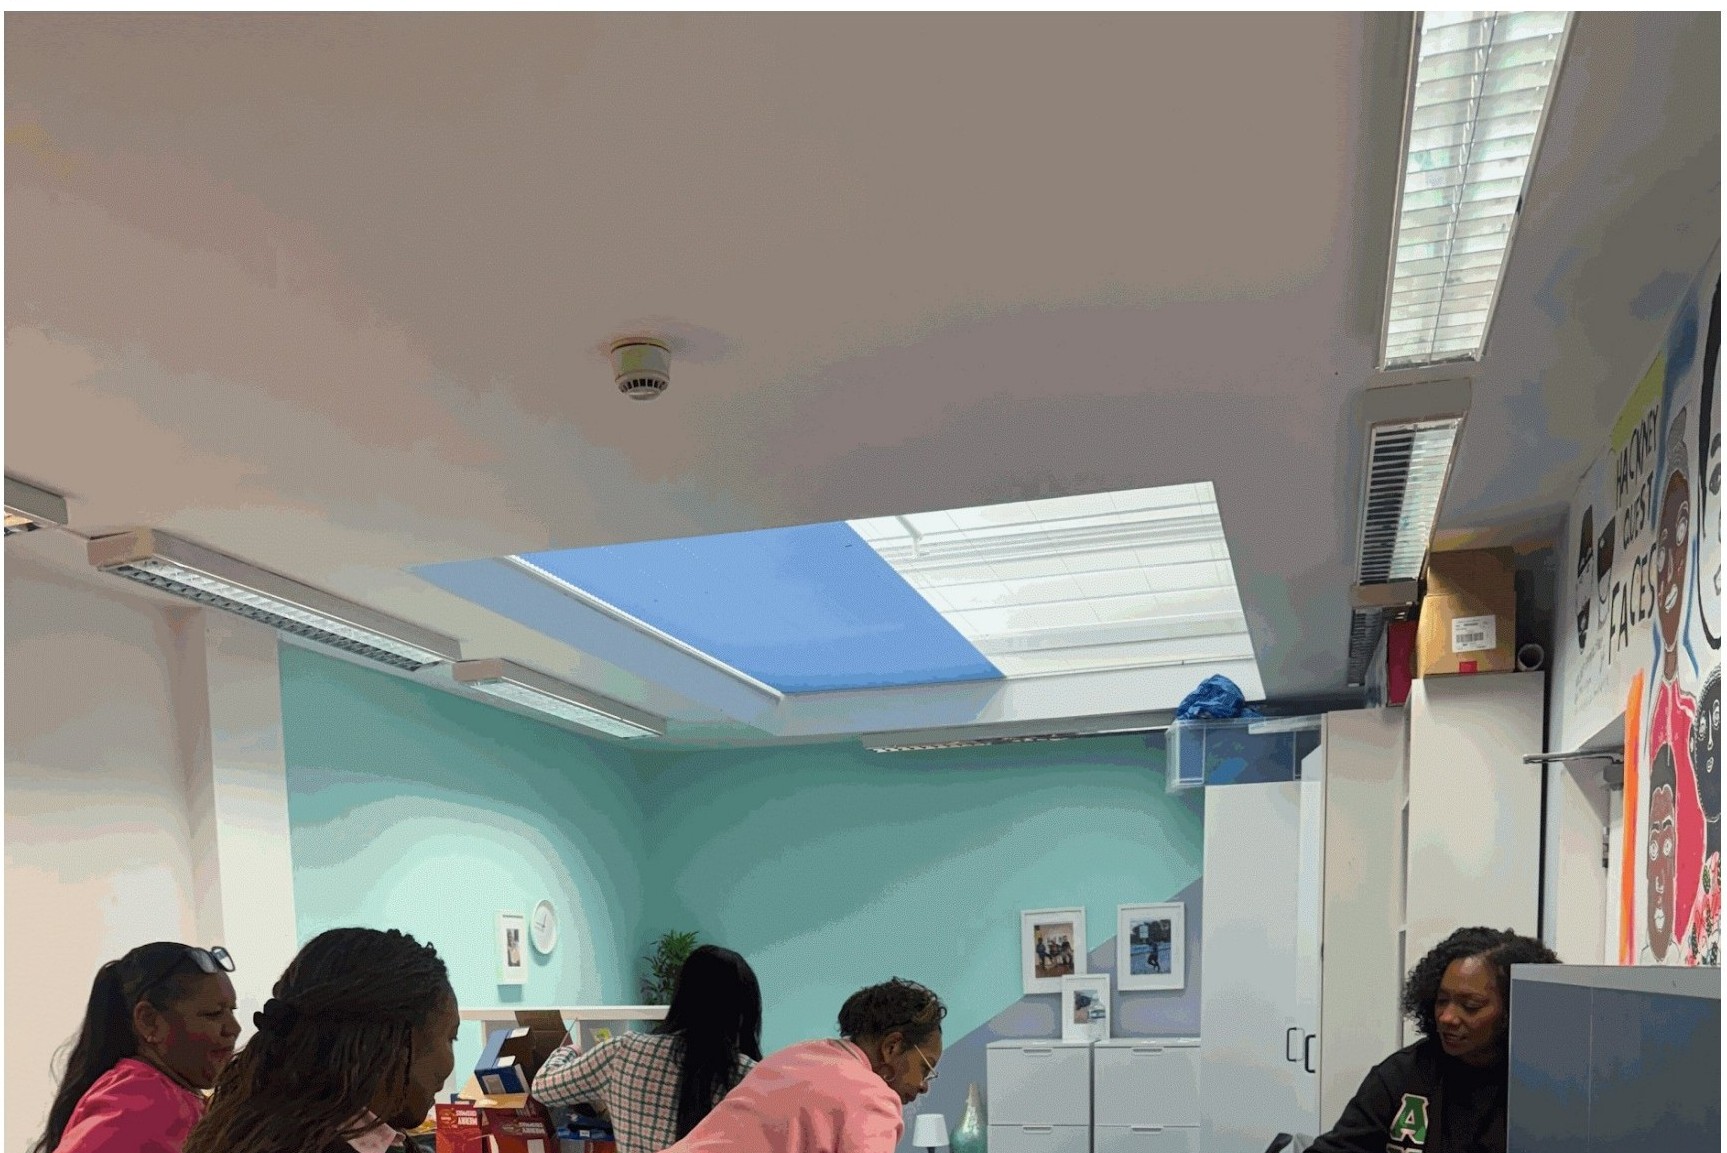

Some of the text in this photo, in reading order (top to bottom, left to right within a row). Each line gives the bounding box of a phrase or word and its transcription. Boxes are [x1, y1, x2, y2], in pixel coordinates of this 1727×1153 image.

[1615, 404, 1660, 511] HACKNEY
[1622, 470, 1655, 551] QUEST
[1608, 542, 1657, 665] FACES
